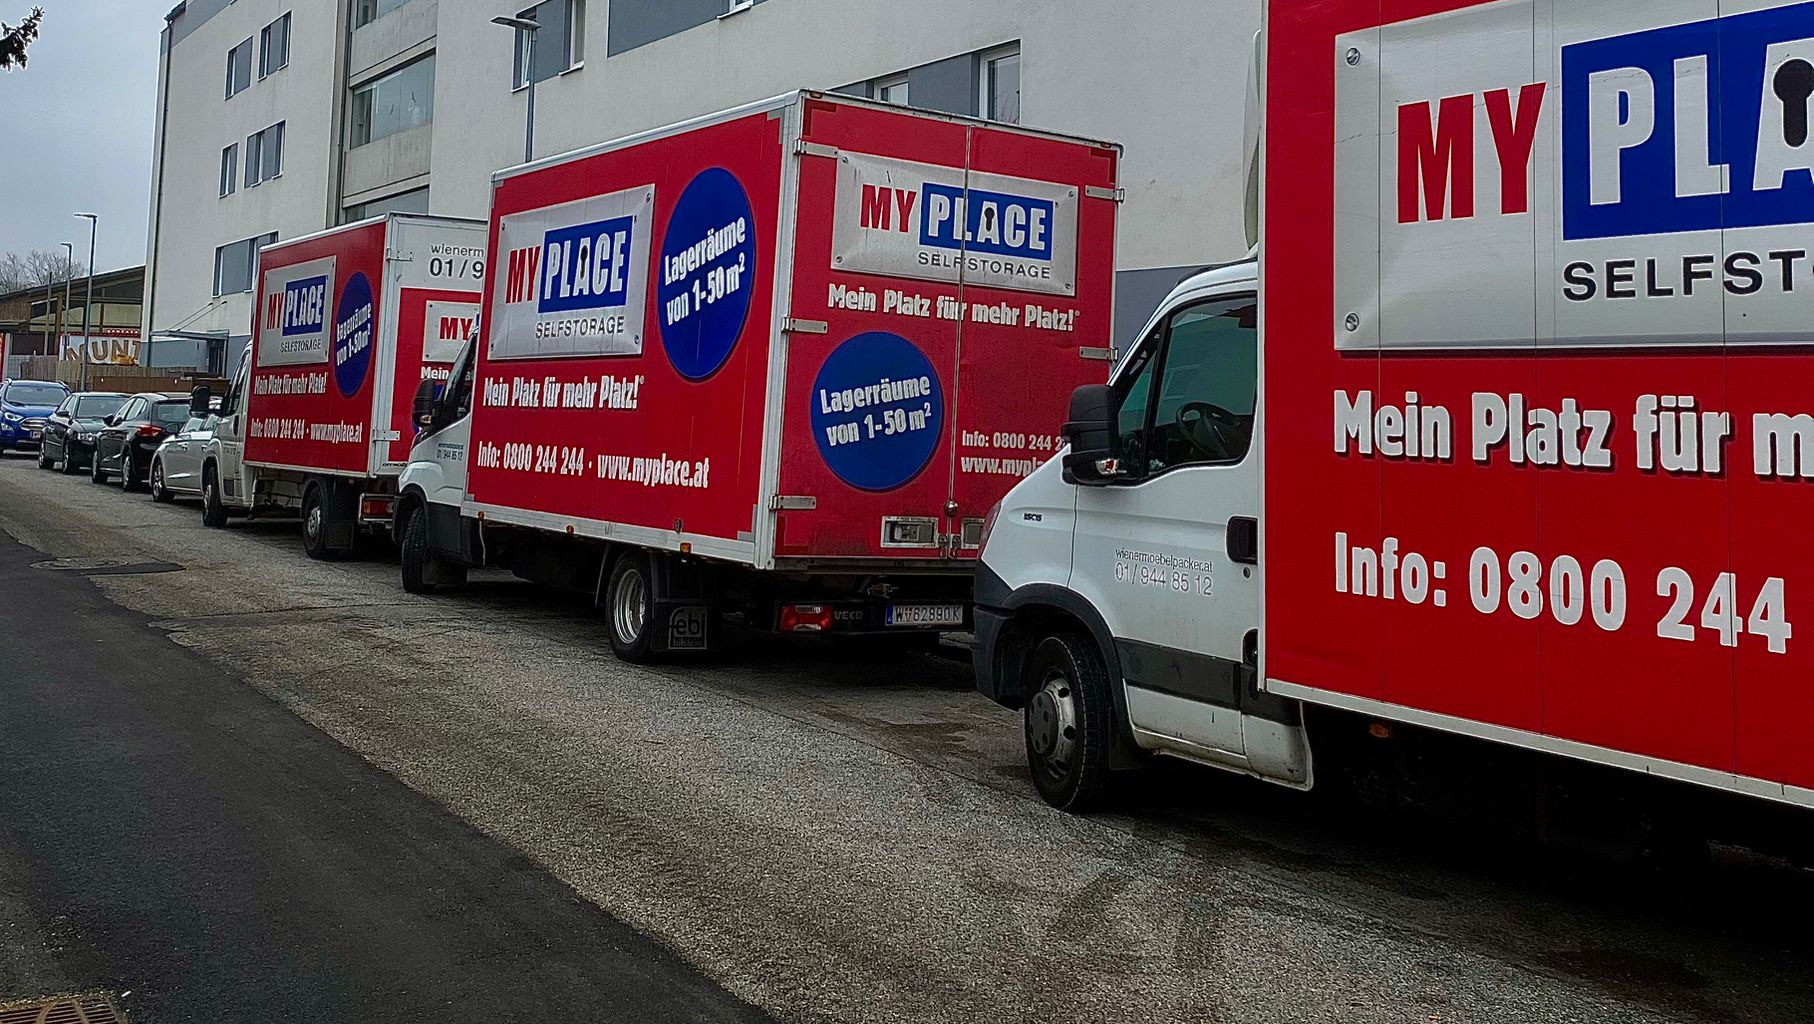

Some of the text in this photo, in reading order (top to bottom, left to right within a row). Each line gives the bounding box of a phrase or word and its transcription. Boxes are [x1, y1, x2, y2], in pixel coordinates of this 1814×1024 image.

[1398, 81, 1547, 224] MY
[860, 183, 1046, 251] MY PLACE
[505, 230, 627, 304] MY PLACE
[665, 217, 745, 285] Lagerräume
[918, 251, 1050, 279] SELFSTORAGE
[267, 284, 324, 329] MY PLACE
[667, 292, 689, 325] von
[828, 283, 876, 311] Mein
[883, 289, 930, 317] Platz
[936, 295, 967, 320] für
[971, 302, 1020, 326] mehr
[439, 317, 474, 341] MY
[536, 315, 625, 339] SELFSTORAGE
[280, 338, 321, 353] SELFSTORAGE
[254, 375, 267, 394] Mein
[268, 375, 282, 394] Platz
[282, 374, 291, 394] für
[292, 373, 307, 393] mehr
[421, 367, 449, 380] Mein
[483, 377, 509, 407] Mein
[511, 377, 540, 407] Platz
[542, 376, 561, 408] für
[562, 376, 597, 408] mehr
[820, 376, 930, 414] Lagerräume
[264, 418, 279, 438] 0800
[280, 419, 292, 438] 244
[293, 419, 305, 439] 244
[311, 420, 362, 444] www.myplace.at
[826, 422, 860, 446] von
[962, 430, 989, 447] Info:
[993, 432, 1025, 449] 0800
[1029, 435, 1052, 450] 244
[1333, 390, 1451, 459] Mein
[1472, 392, 1611, 468] Platz
[1633, 394, 1730, 473] für
[477, 441, 500, 468] Info:
[503, 443, 532, 471] 0800
[535, 445, 557, 473] 244
[560, 447, 584, 476] 244
[598, 453, 709, 488] www.myplace.at
[1115, 548, 1213, 573] wienermoebelpacker.at
[1171, 571, 1189, 592] 85
[1195, 575, 1213, 595] 12
[1334, 532, 1792, 654] Info: 0800 244
